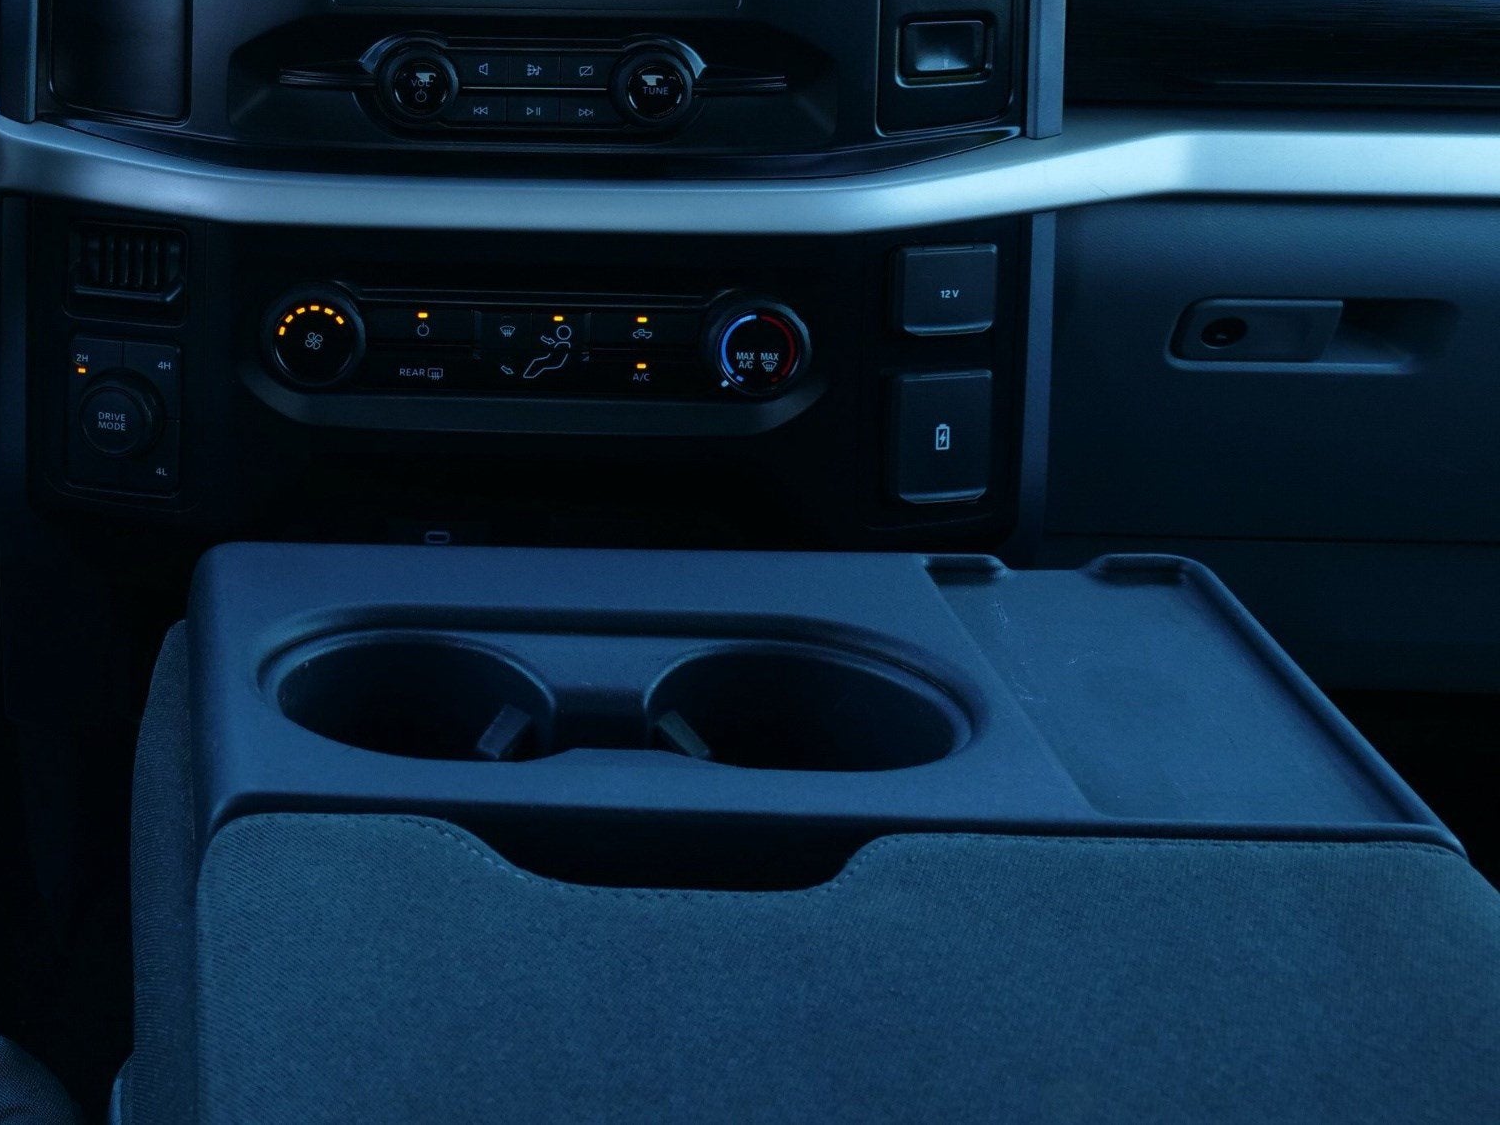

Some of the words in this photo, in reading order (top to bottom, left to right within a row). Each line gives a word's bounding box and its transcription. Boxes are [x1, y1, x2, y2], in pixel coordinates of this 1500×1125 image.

[411, 79, 433, 88] VOL
[643, 86, 669, 95] TUNE
[76, 354, 89, 362] 2H
[736, 352, 755, 361] MAX
[760, 352, 779, 361] MAX
[157, 362, 171, 370] 4H
[738, 361, 753, 369] A/C
[399, 368, 426, 377] REAR
[633, 372, 650, 381] A/C
[98, 411, 126, 421] DRIVE
[98, 421, 126, 431] MODE
[155, 467, 168, 476] 4L
